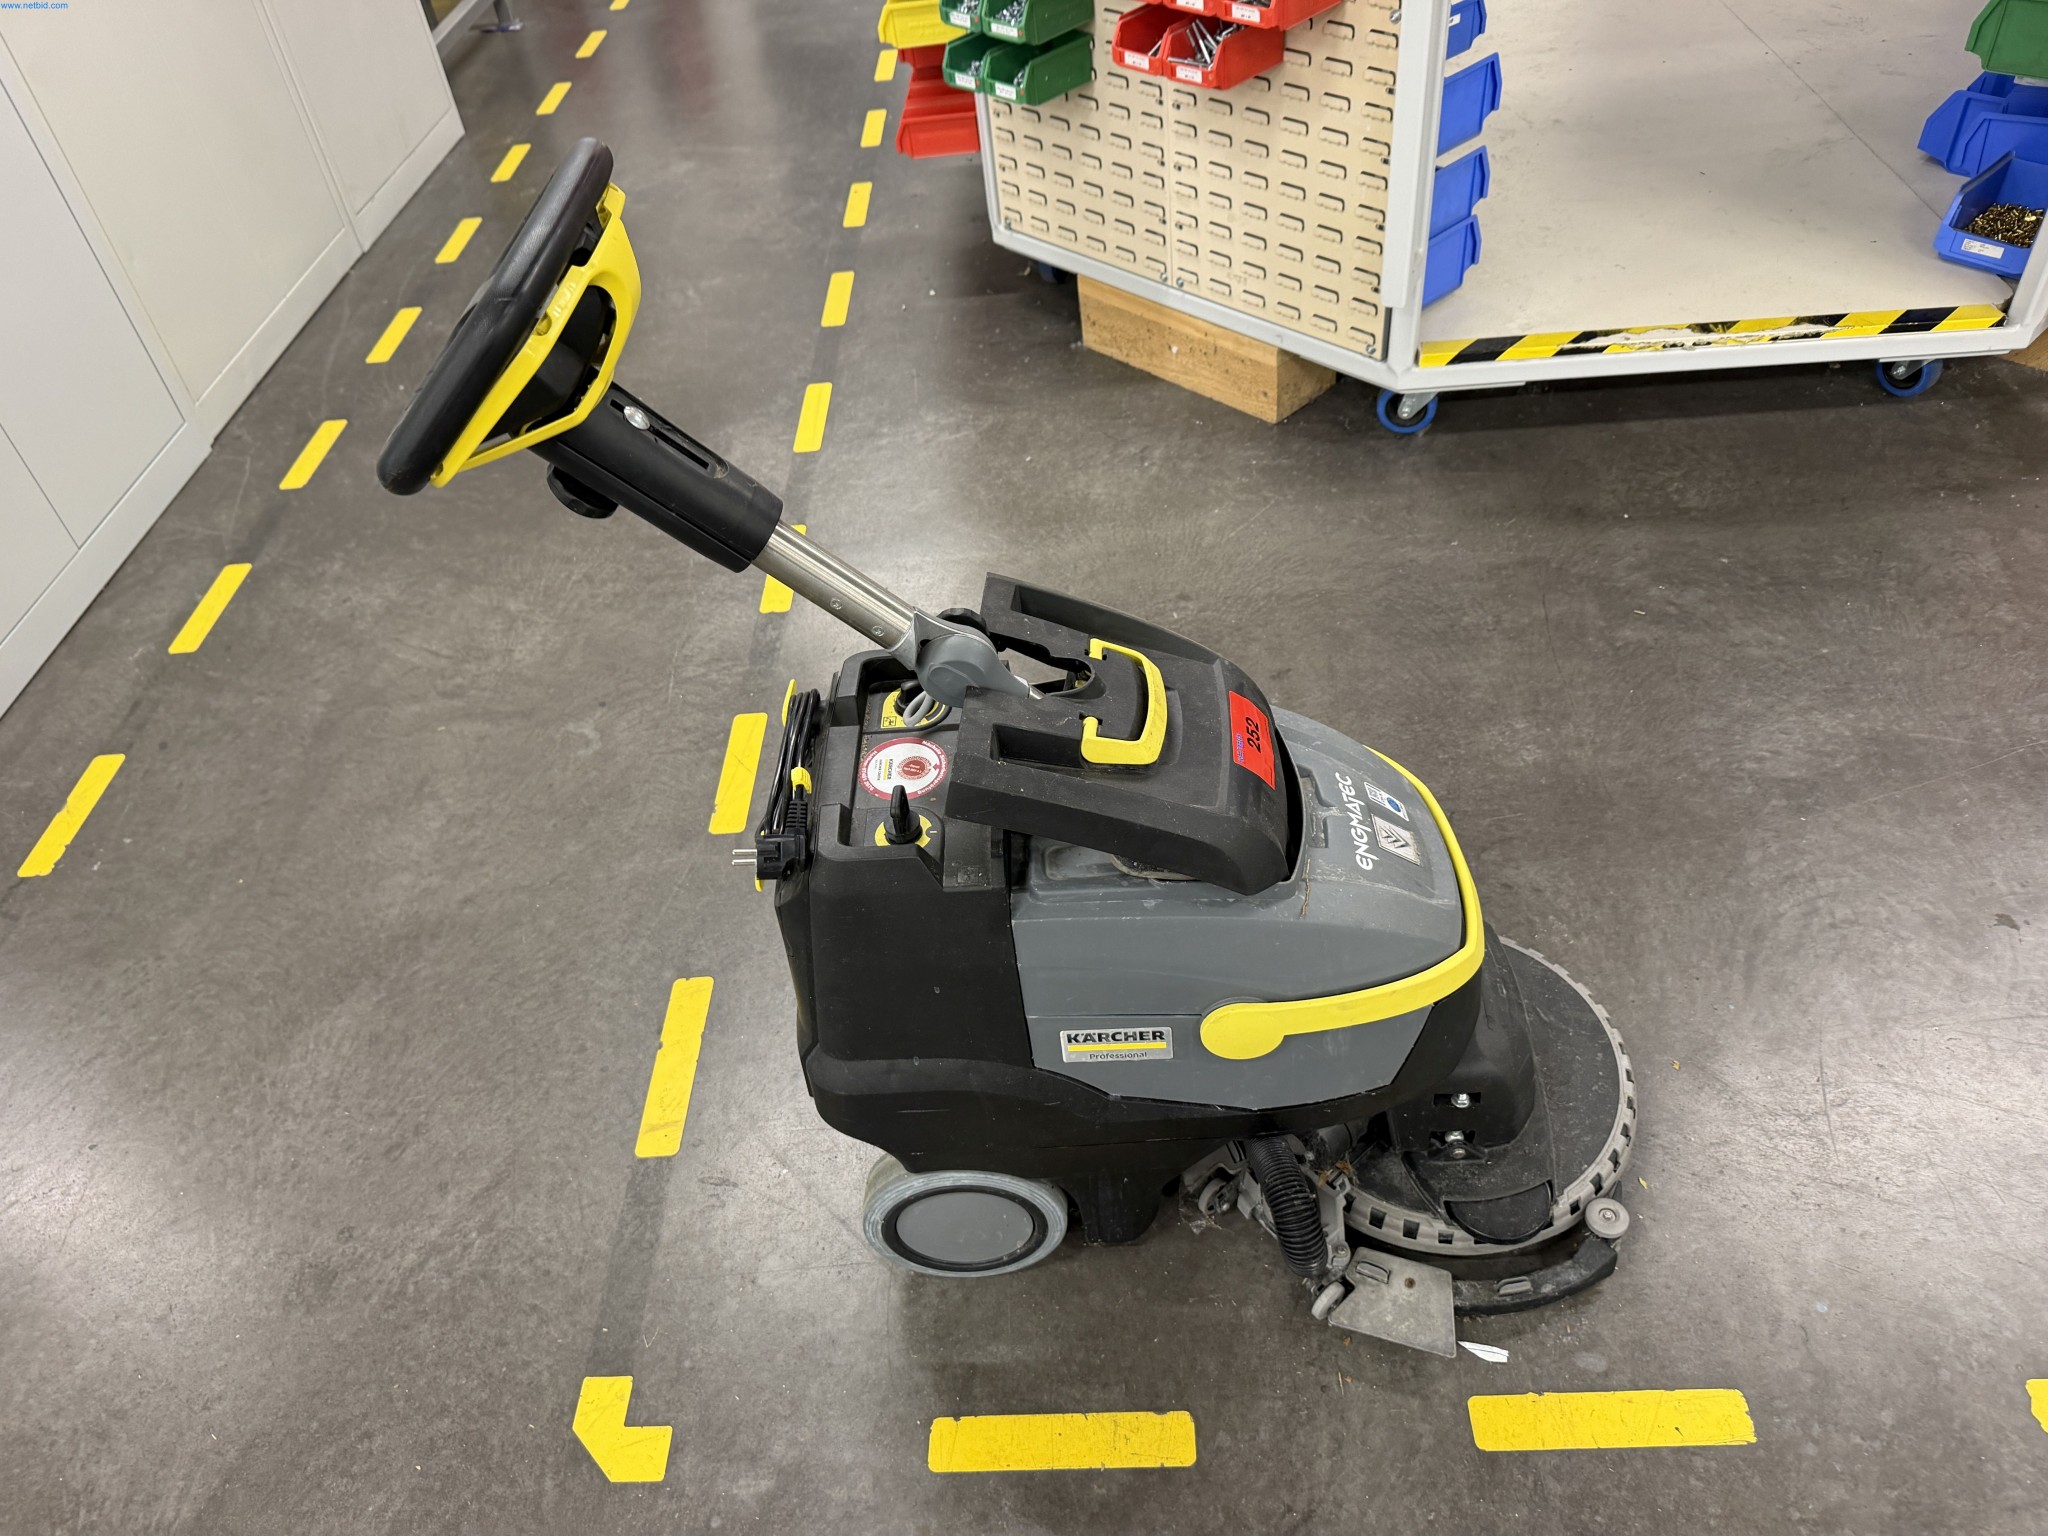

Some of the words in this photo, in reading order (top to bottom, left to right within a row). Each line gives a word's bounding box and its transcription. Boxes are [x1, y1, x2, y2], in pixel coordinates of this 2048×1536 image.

[1245, 716, 1261, 753] 252
[1066, 1030, 1165, 1044] KÄRCHER
[1089, 1051, 1148, 1060] Professional
